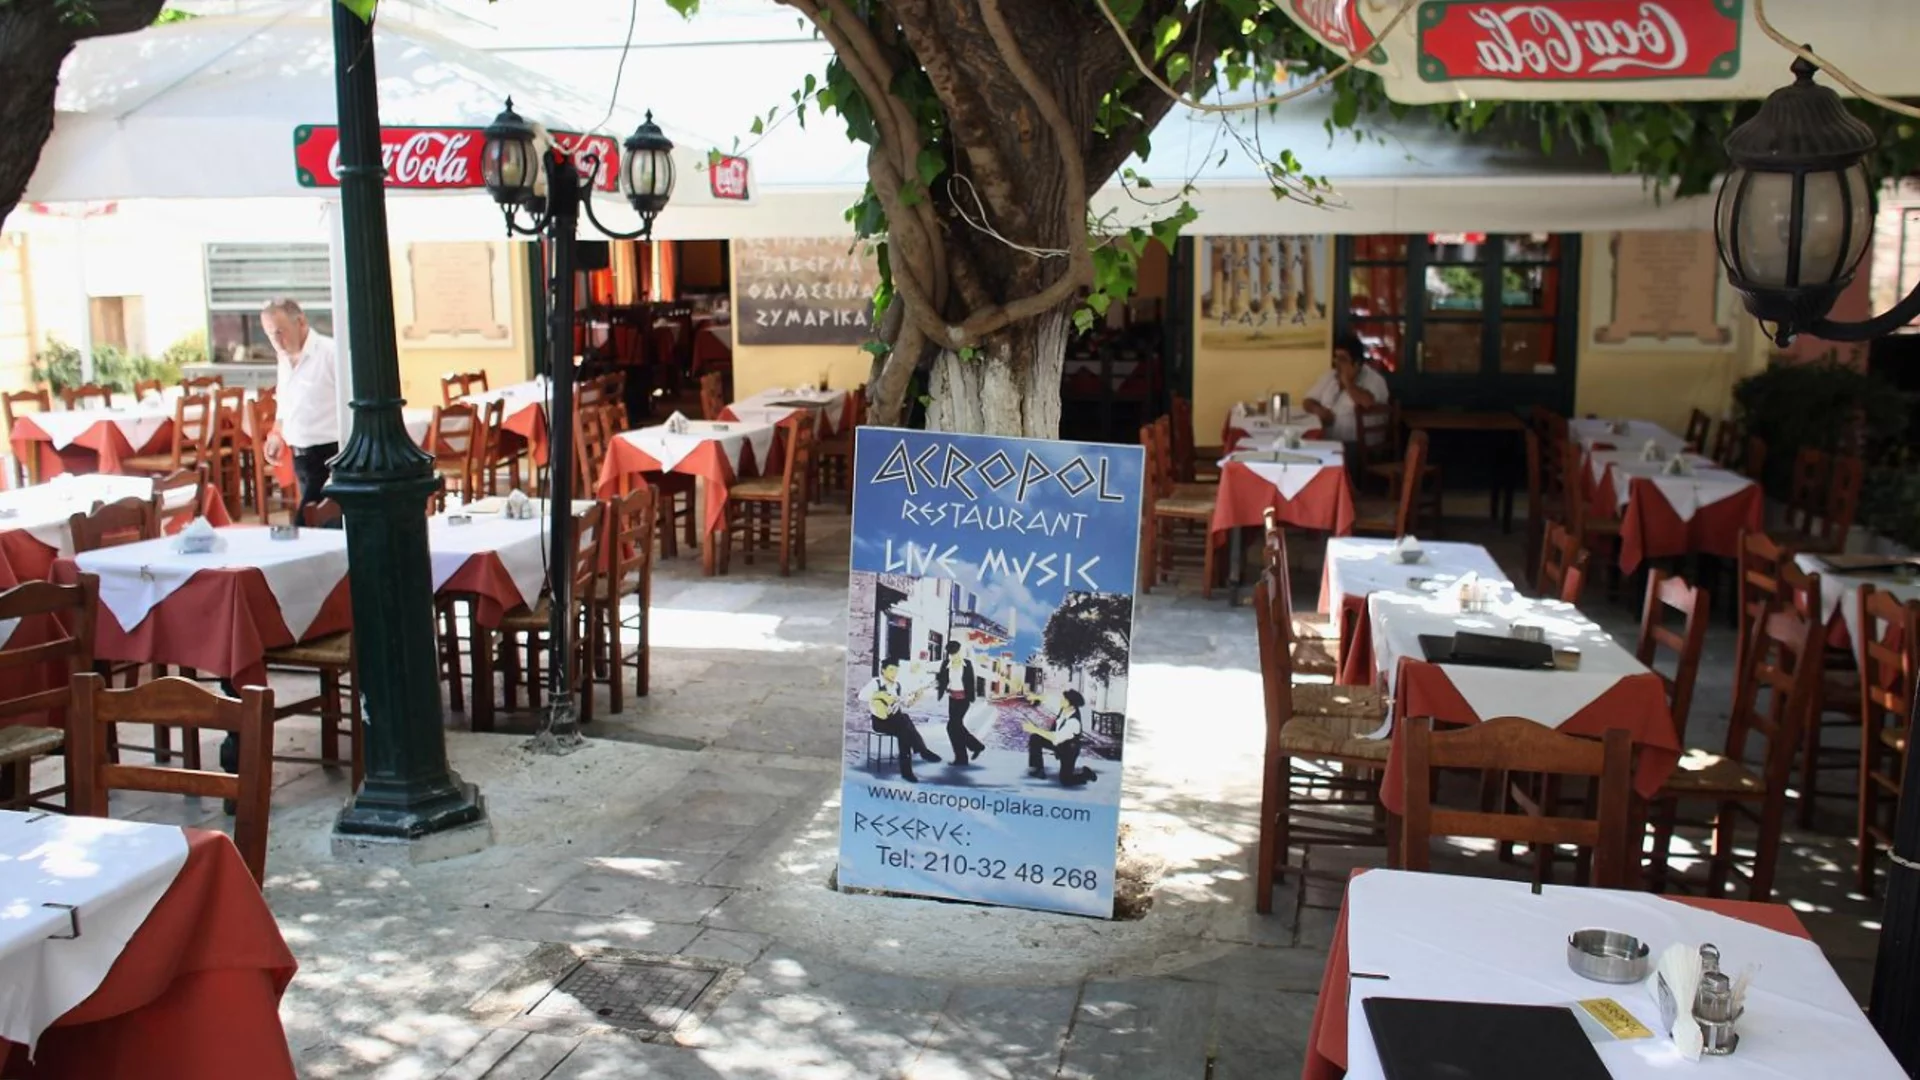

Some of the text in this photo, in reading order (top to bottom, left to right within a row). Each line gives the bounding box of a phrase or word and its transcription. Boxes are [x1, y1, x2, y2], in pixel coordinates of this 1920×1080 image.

[755, 308, 868, 327] ΖΥΜΑΡΙΚΑ
[1220, 311, 1307, 327] PASTA
[870, 439, 1124, 502] ACROPOL
[901, 499, 1088, 539] RESTAURANT
[884, 539, 960, 579] LIVE
[868, 785, 1091, 822] www.acropol-plaka.com
[854, 811, 972, 847] RESERVE:
[876, 844, 1097, 891] Tel: 210-32 48 268
